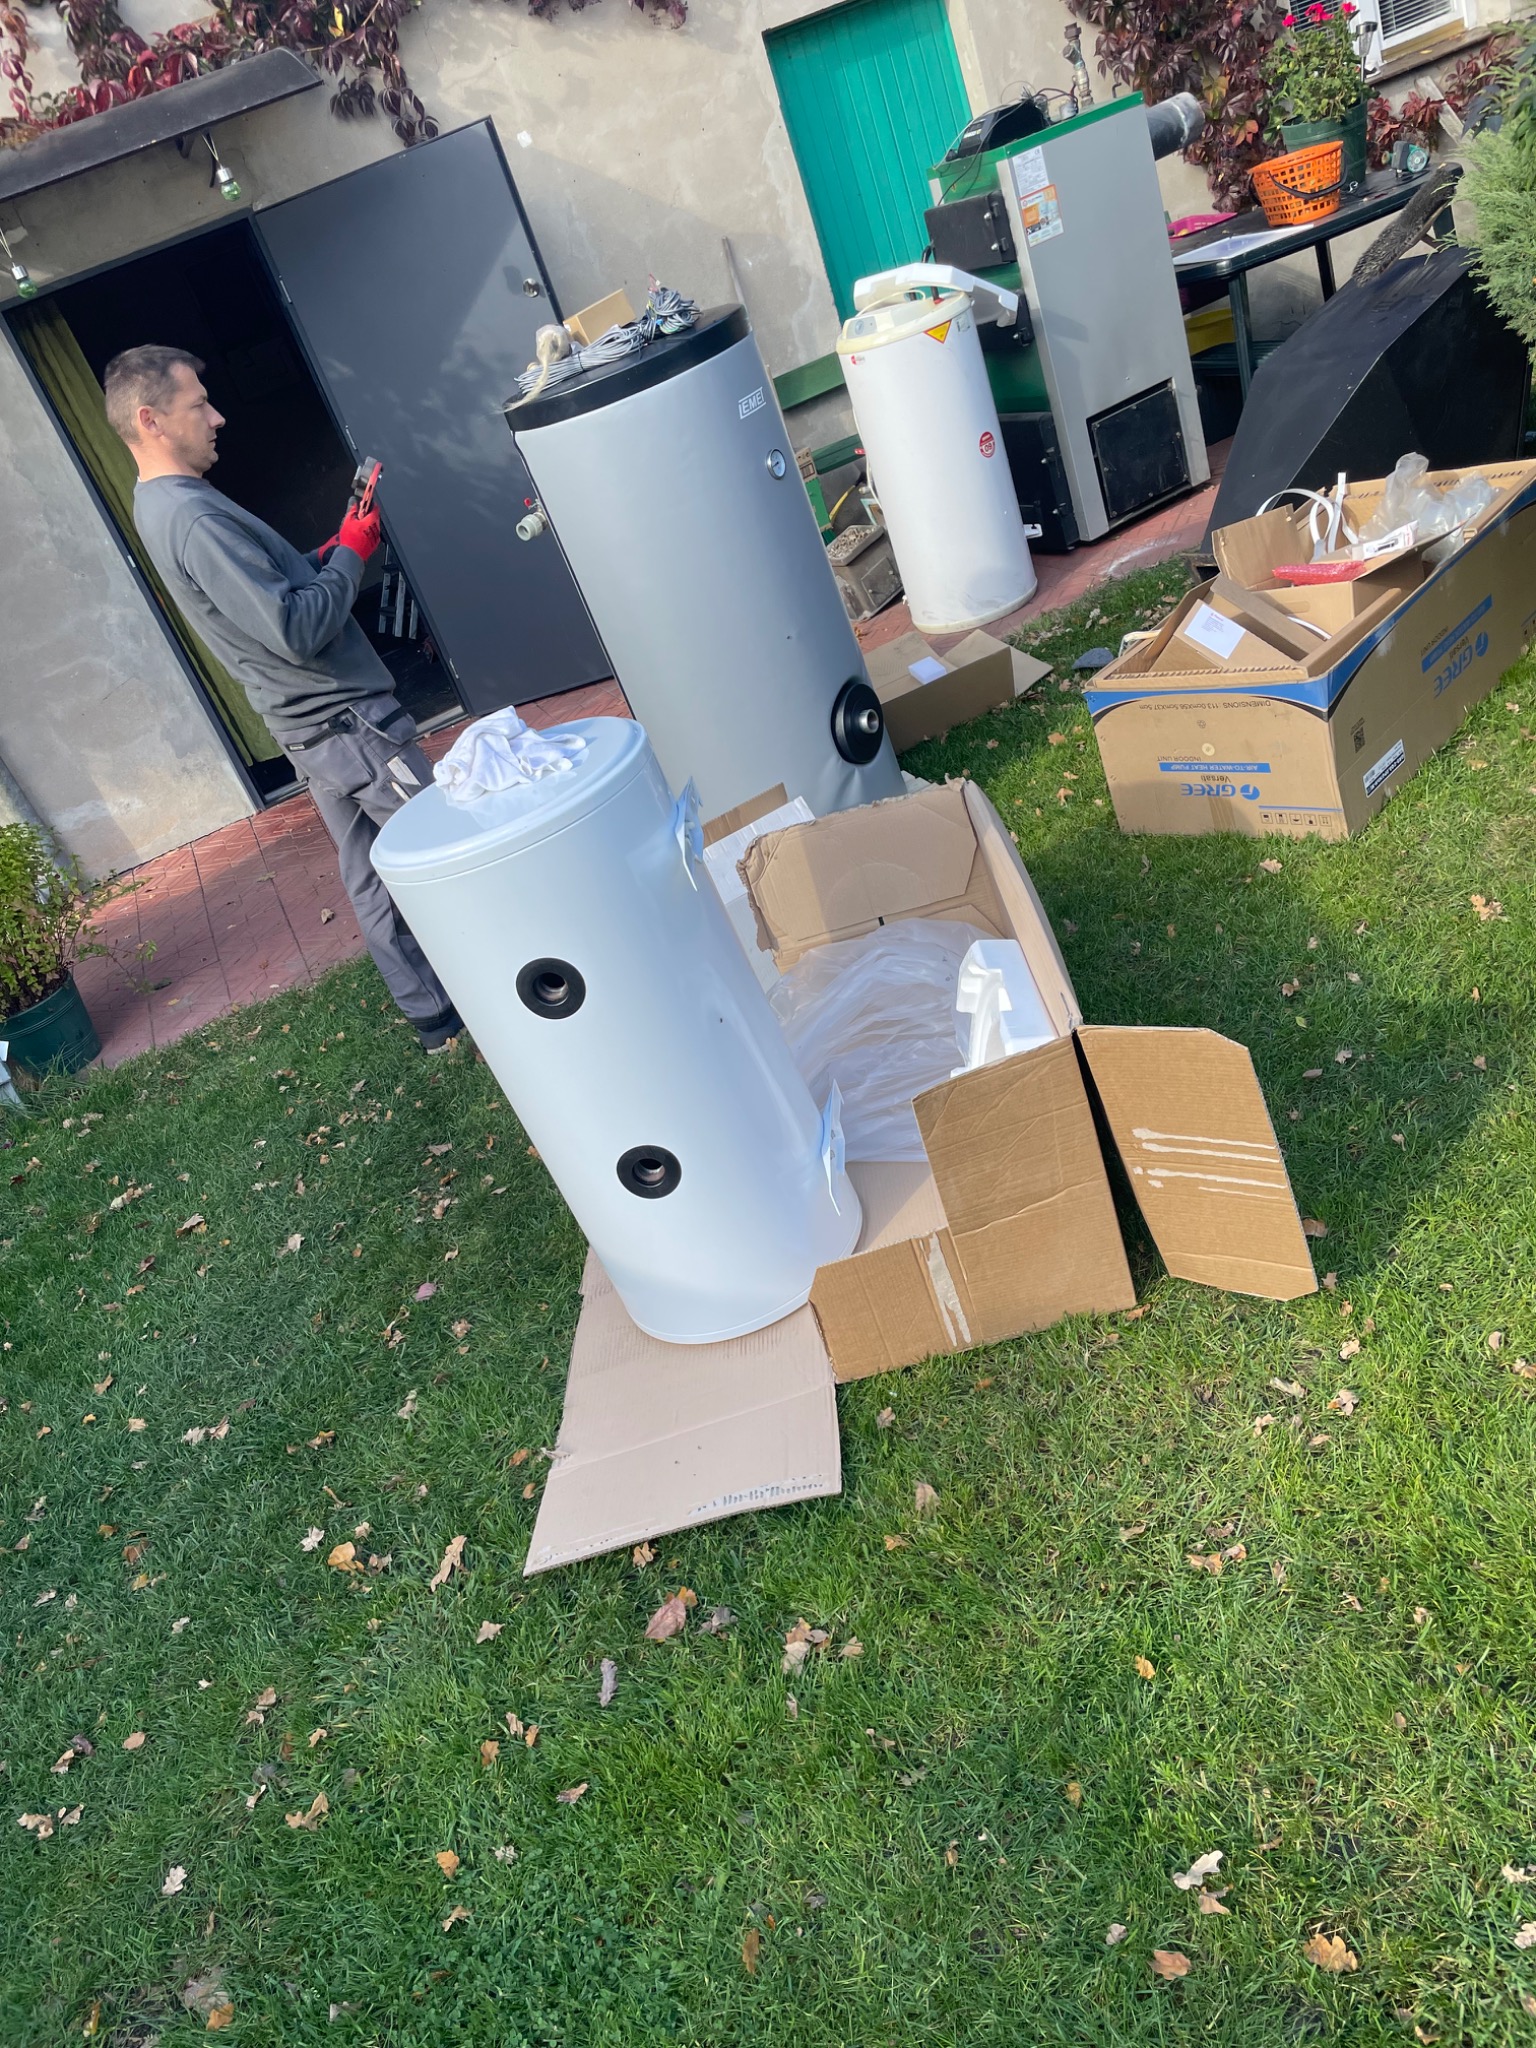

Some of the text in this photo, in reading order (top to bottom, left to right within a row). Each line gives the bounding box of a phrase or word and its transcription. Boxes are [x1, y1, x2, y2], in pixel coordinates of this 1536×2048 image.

[1433, 645, 1473, 699] GREE
[1200, 775, 1231, 783] Versati
[1181, 783, 1236, 797] GREE
